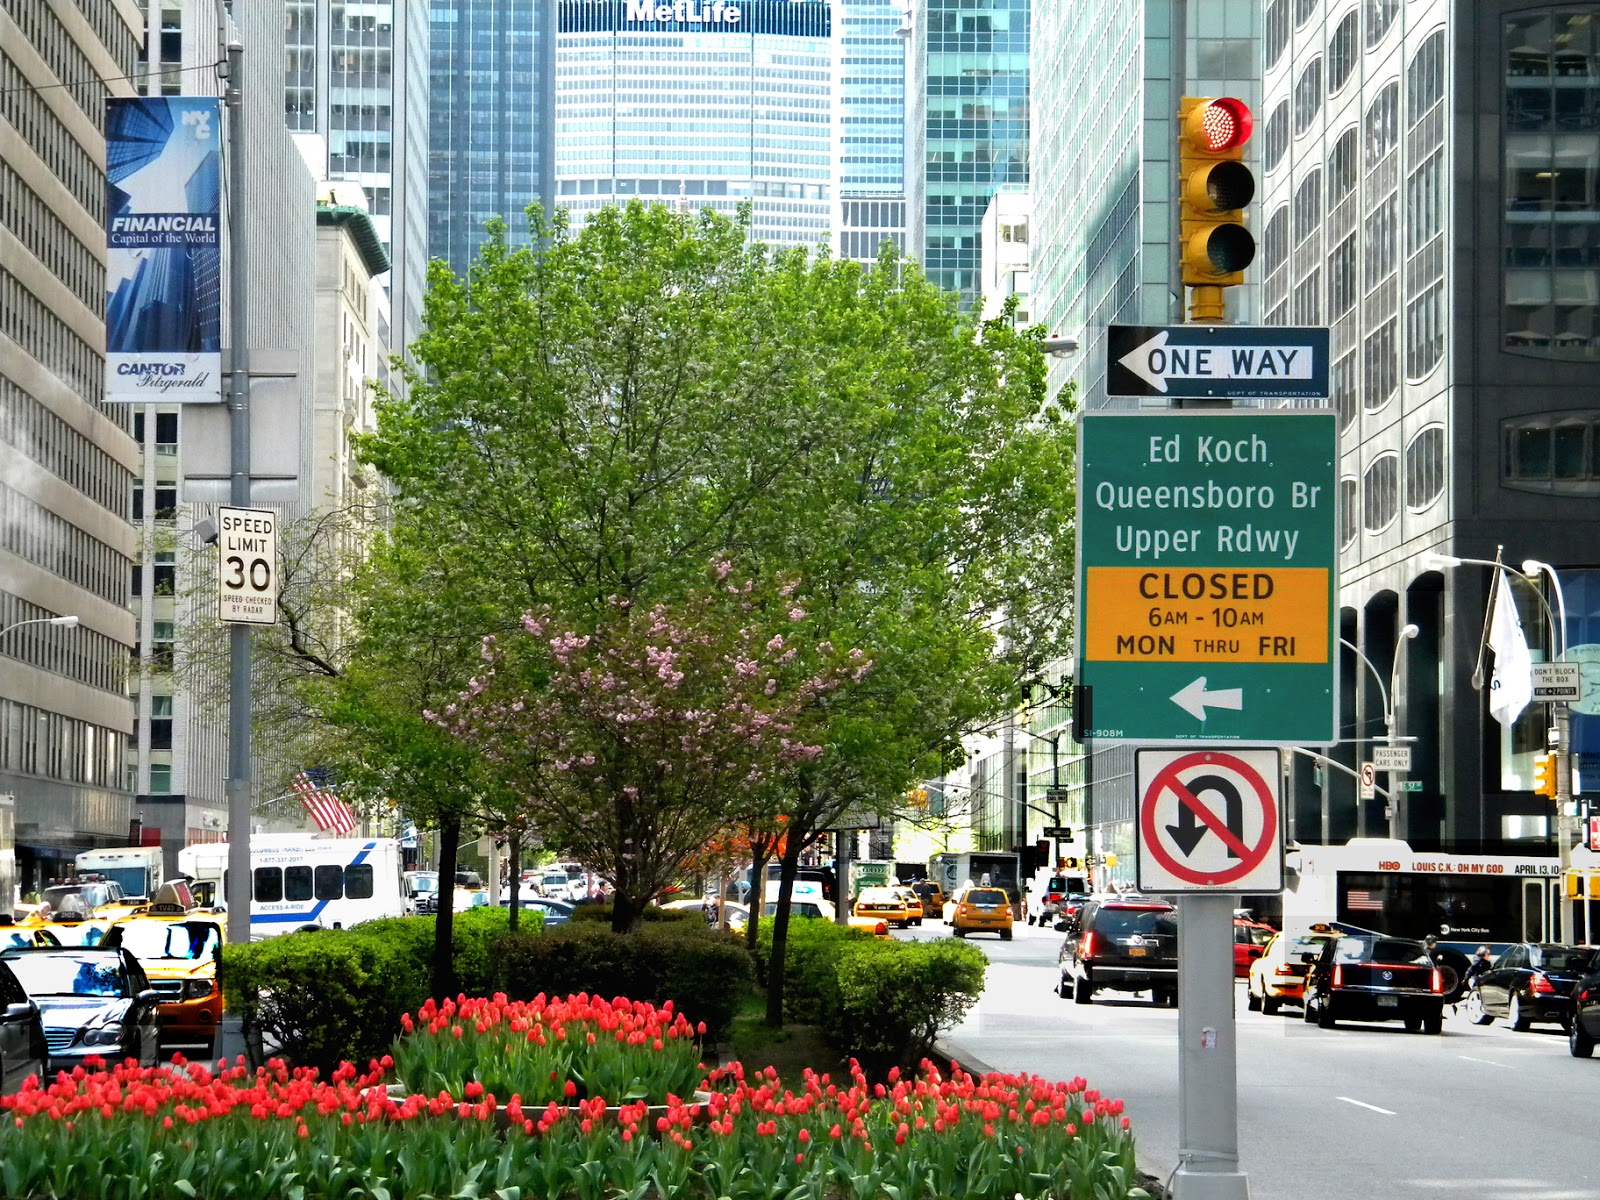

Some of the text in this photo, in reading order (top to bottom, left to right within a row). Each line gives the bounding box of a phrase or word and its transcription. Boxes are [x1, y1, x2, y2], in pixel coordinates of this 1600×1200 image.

[627, 0, 741, 23] MetLife
[111, 216, 216, 232] FINANCIAL
[111, 232, 216, 246] Capital of the World
[117, 362, 186, 376] CANTOR
[1148, 348, 1298, 376] ONE WAY
[136, 368, 209, 395] Fitzgerald
[1149, 433, 1267, 463] Ed Koch
[1096, 480, 1321, 511] Queensboro Br
[223, 516, 272, 534] SPEED
[228, 536, 267, 553] LIMIT
[1115, 523, 1299, 560] Upper Rdwy
[225, 555, 271, 592] 30
[1139, 572, 1274, 600] CLOSED
[223, 594, 272, 606] SPEED CHECKED
[232, 604, 263, 614] BY RADAR
[1148, 607, 1188, 627] 6AM
[1211, 607, 1265, 628] 10AM
[1116, 635, 1296, 656] MON THRU FRI
[1555, 667, 1576, 675] BLOCK
[1556, 687, 1575, 695] POINTS
[1083, 729, 1123, 737] SI-908M
[1375, 750, 1408, 758] PASSENGER
[1375, 759, 1408, 767] CARS ONLY
[1378, 861, 1401, 870] HBO
[1412, 862, 1437, 872] LOUIS
[1457, 863, 1470, 873] OH
[1471, 863, 1484, 873] MY
[1486, 863, 1504, 873] GOD
[1514, 864, 1538, 874] APRIL
[1539, 864, 1550, 875] 13,
[259, 903, 305, 911] ACCESS-A-RIDE
